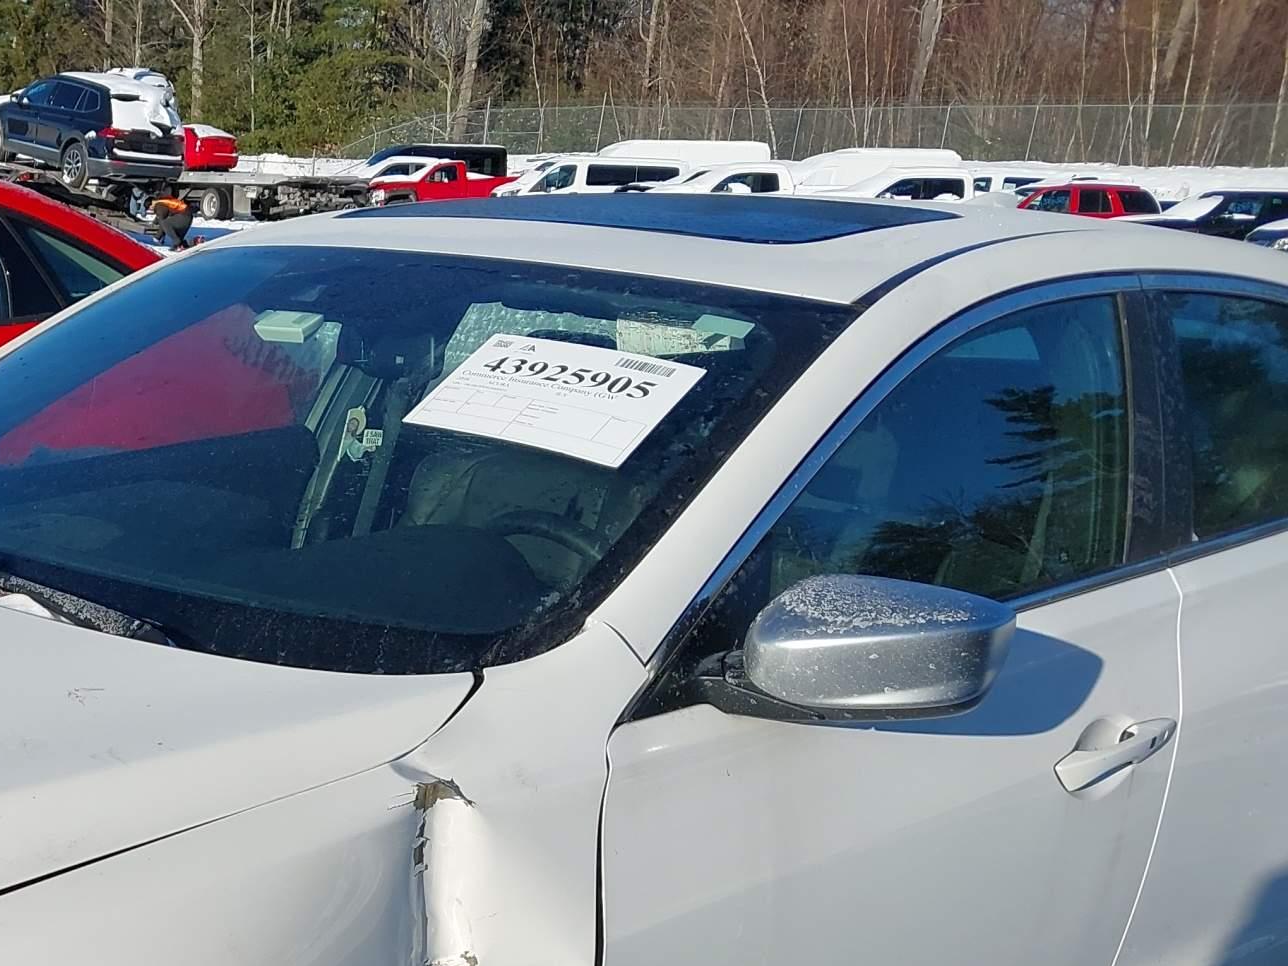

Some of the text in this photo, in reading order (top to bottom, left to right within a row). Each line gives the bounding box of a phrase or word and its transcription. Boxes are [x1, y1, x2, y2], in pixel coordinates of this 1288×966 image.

[462, 369, 507, 382] Commerce
[508, 376, 550, 389] Insurance
[551, 382, 593, 397] Company
[483, 356, 658, 399] 43925905
